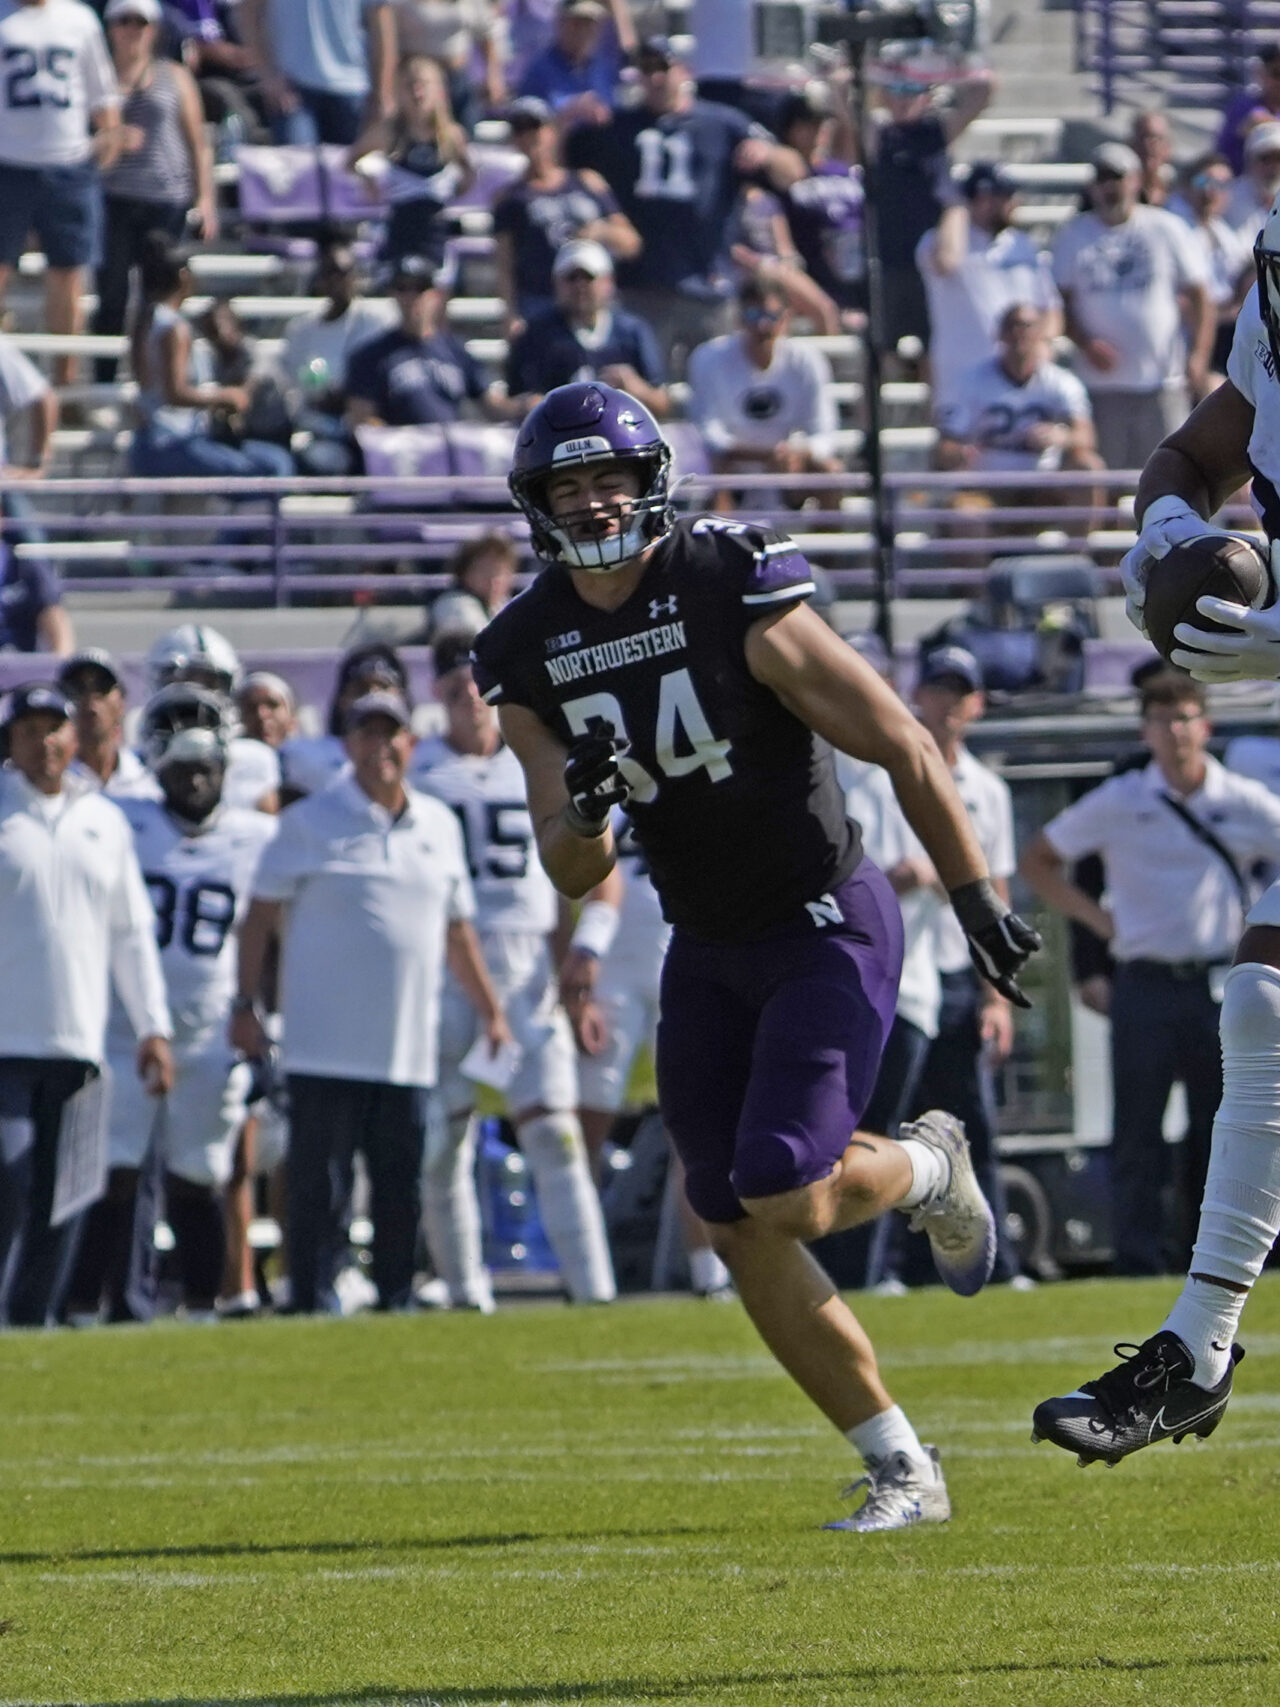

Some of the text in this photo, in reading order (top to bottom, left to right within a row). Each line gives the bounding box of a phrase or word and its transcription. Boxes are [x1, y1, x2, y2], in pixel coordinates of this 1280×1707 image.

[5, 47, 73, 109] 25
[634, 128, 696, 199] 11
[545, 621, 687, 686] NORTHWESTERN
[804, 893, 844, 928] N
